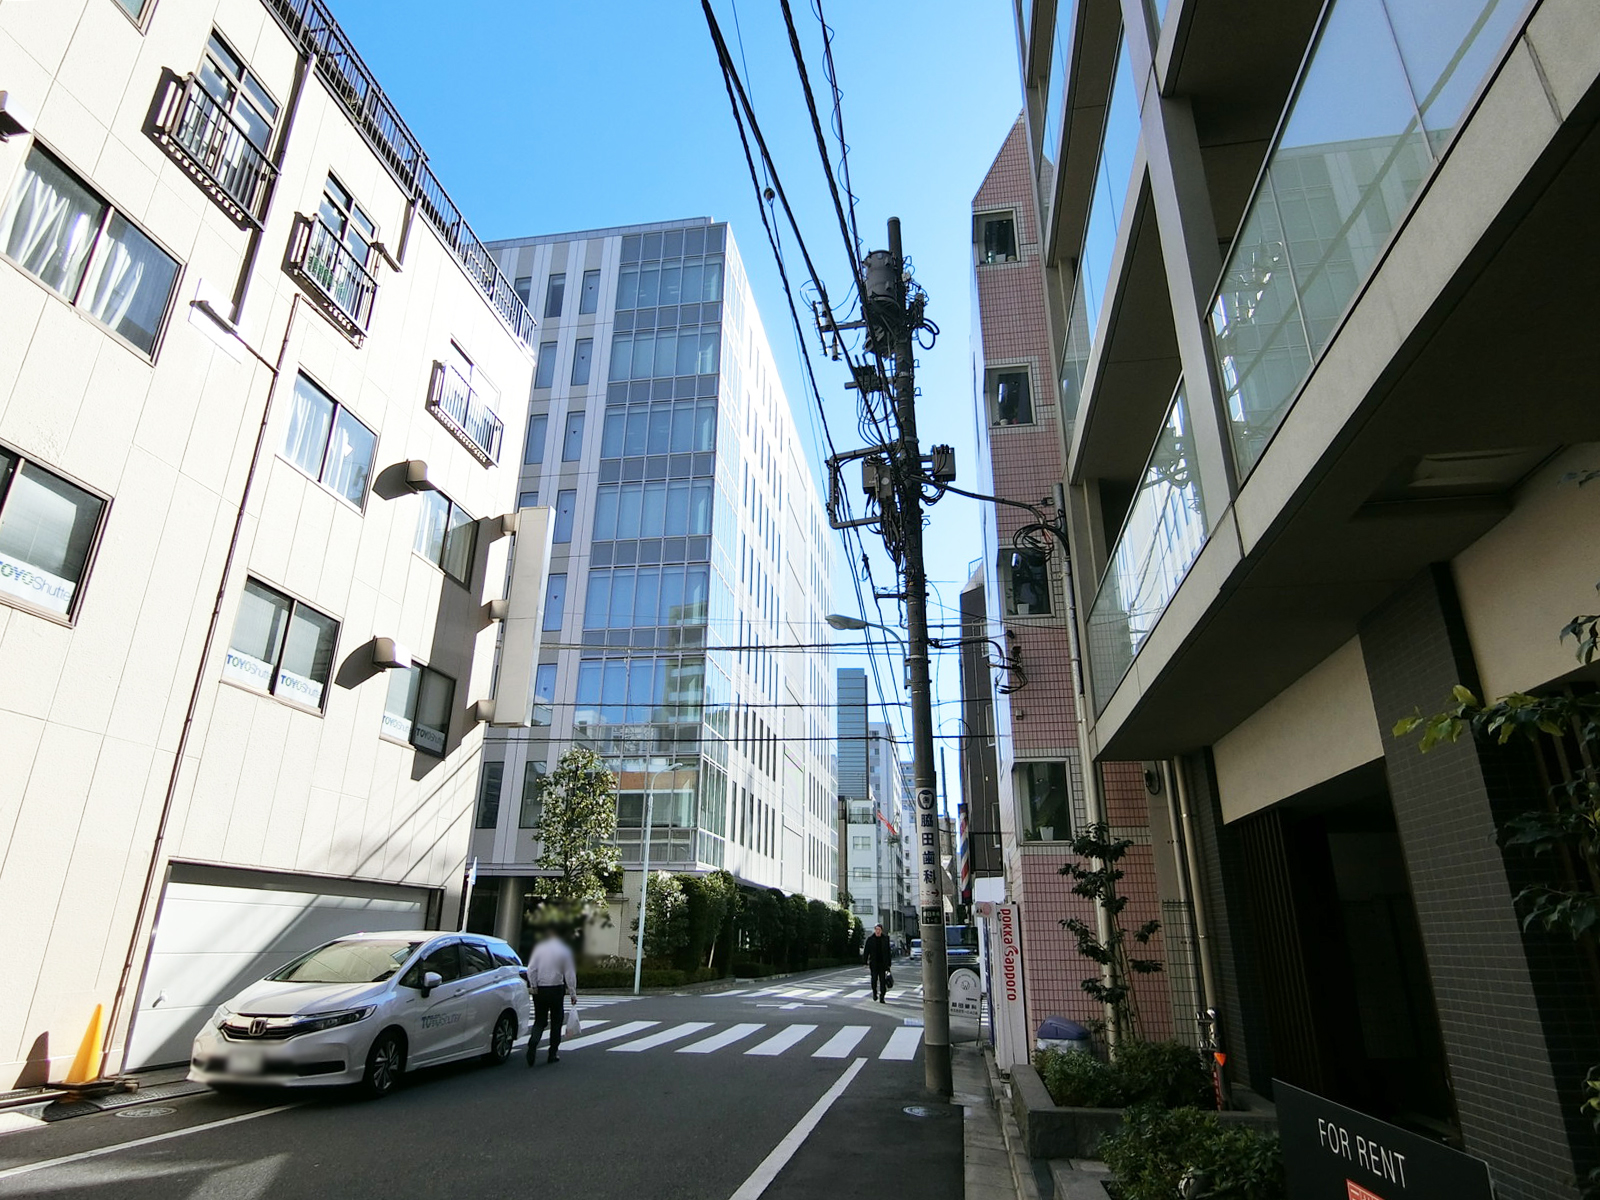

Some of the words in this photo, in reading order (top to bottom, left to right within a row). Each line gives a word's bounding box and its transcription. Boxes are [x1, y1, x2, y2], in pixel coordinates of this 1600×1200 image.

[921, 813, 937, 884] 脇田歯科
[1318, 1118, 1352, 1161] FOR
[1356, 1135, 1406, 1189] RENT
